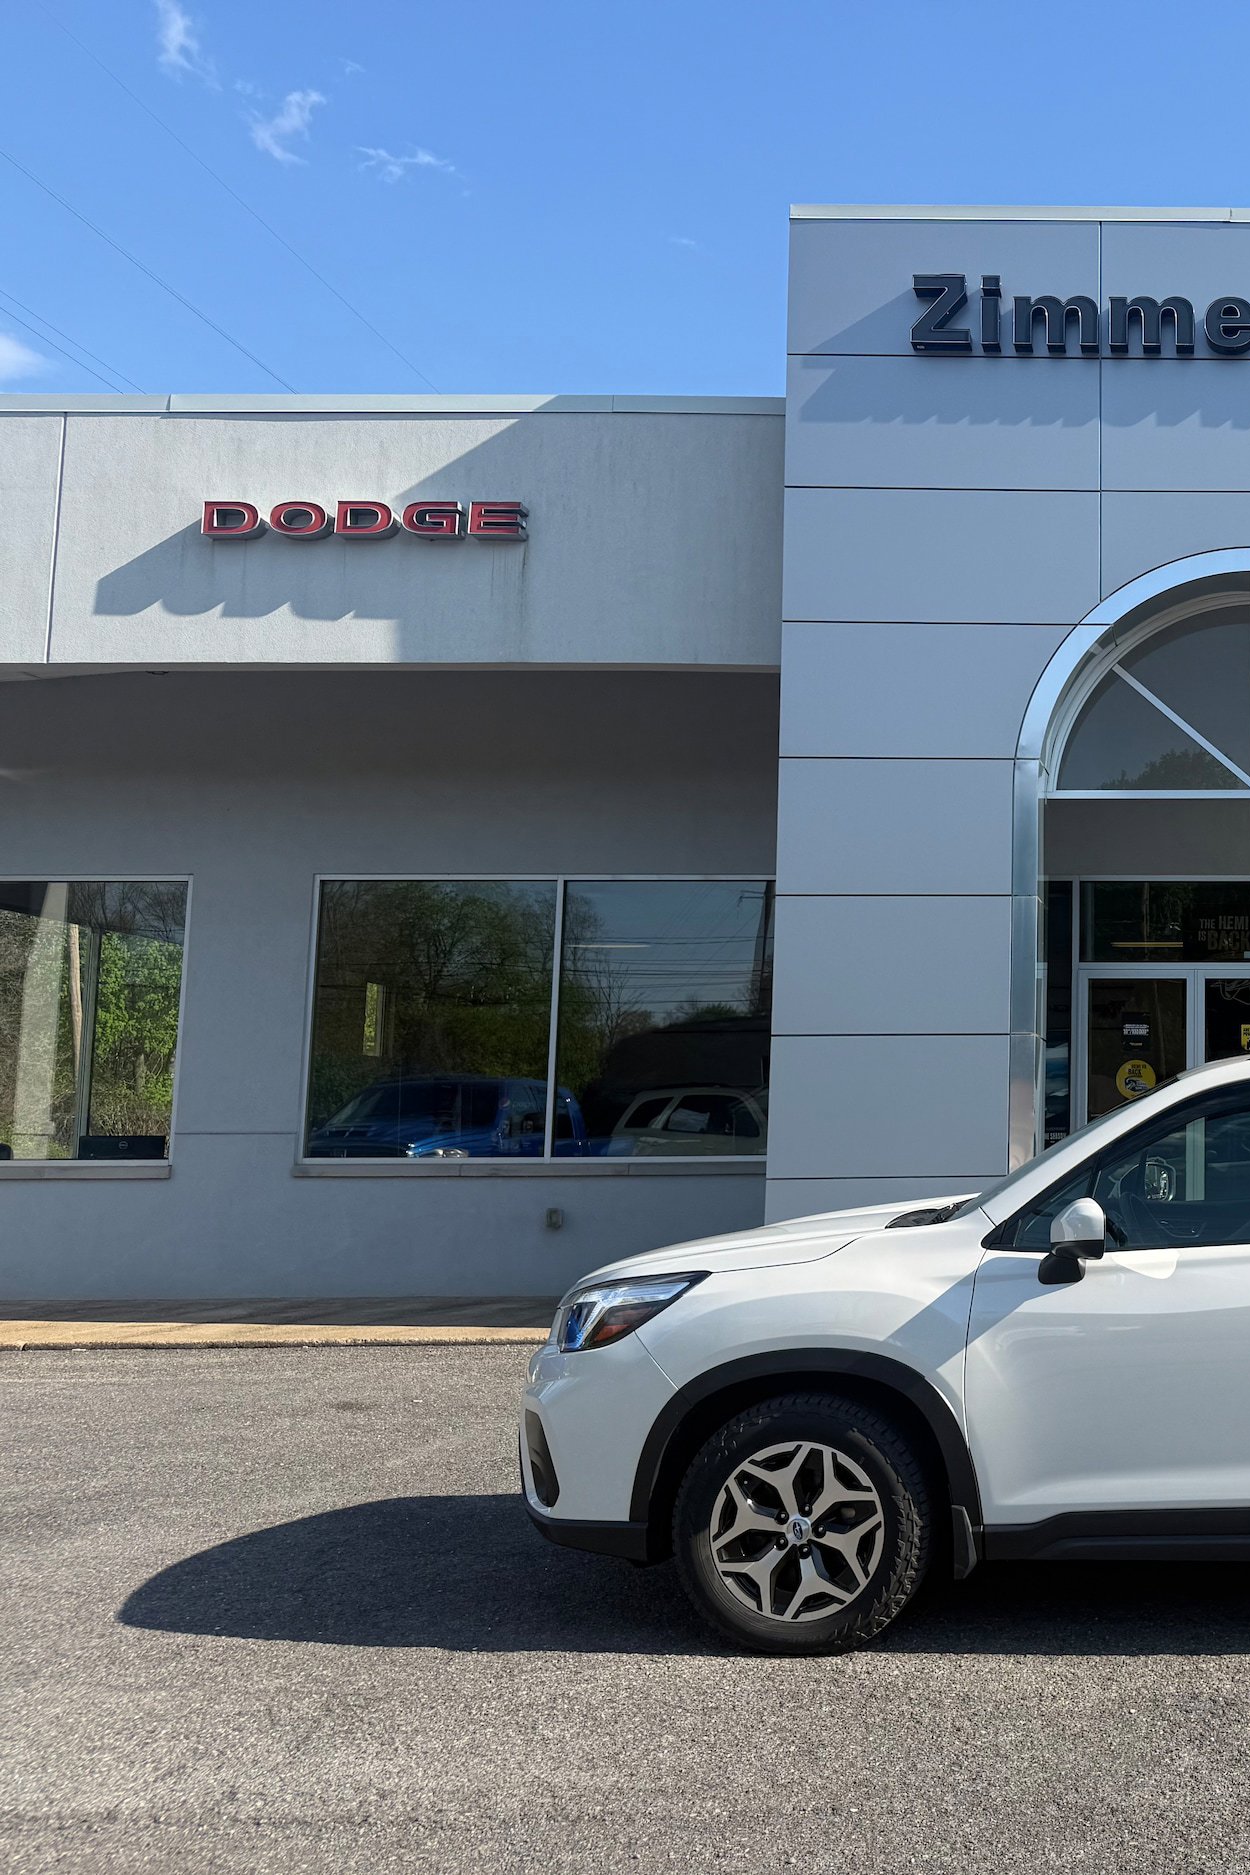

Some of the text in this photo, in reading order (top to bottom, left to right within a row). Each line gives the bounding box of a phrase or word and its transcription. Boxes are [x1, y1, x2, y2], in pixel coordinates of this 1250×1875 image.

[201, 500, 529, 541] DODGE
[1199, 918, 1216, 929] THE
[1218, 915, 1249, 930] HEMI
[1198, 930, 1250, 951] IS BACK
